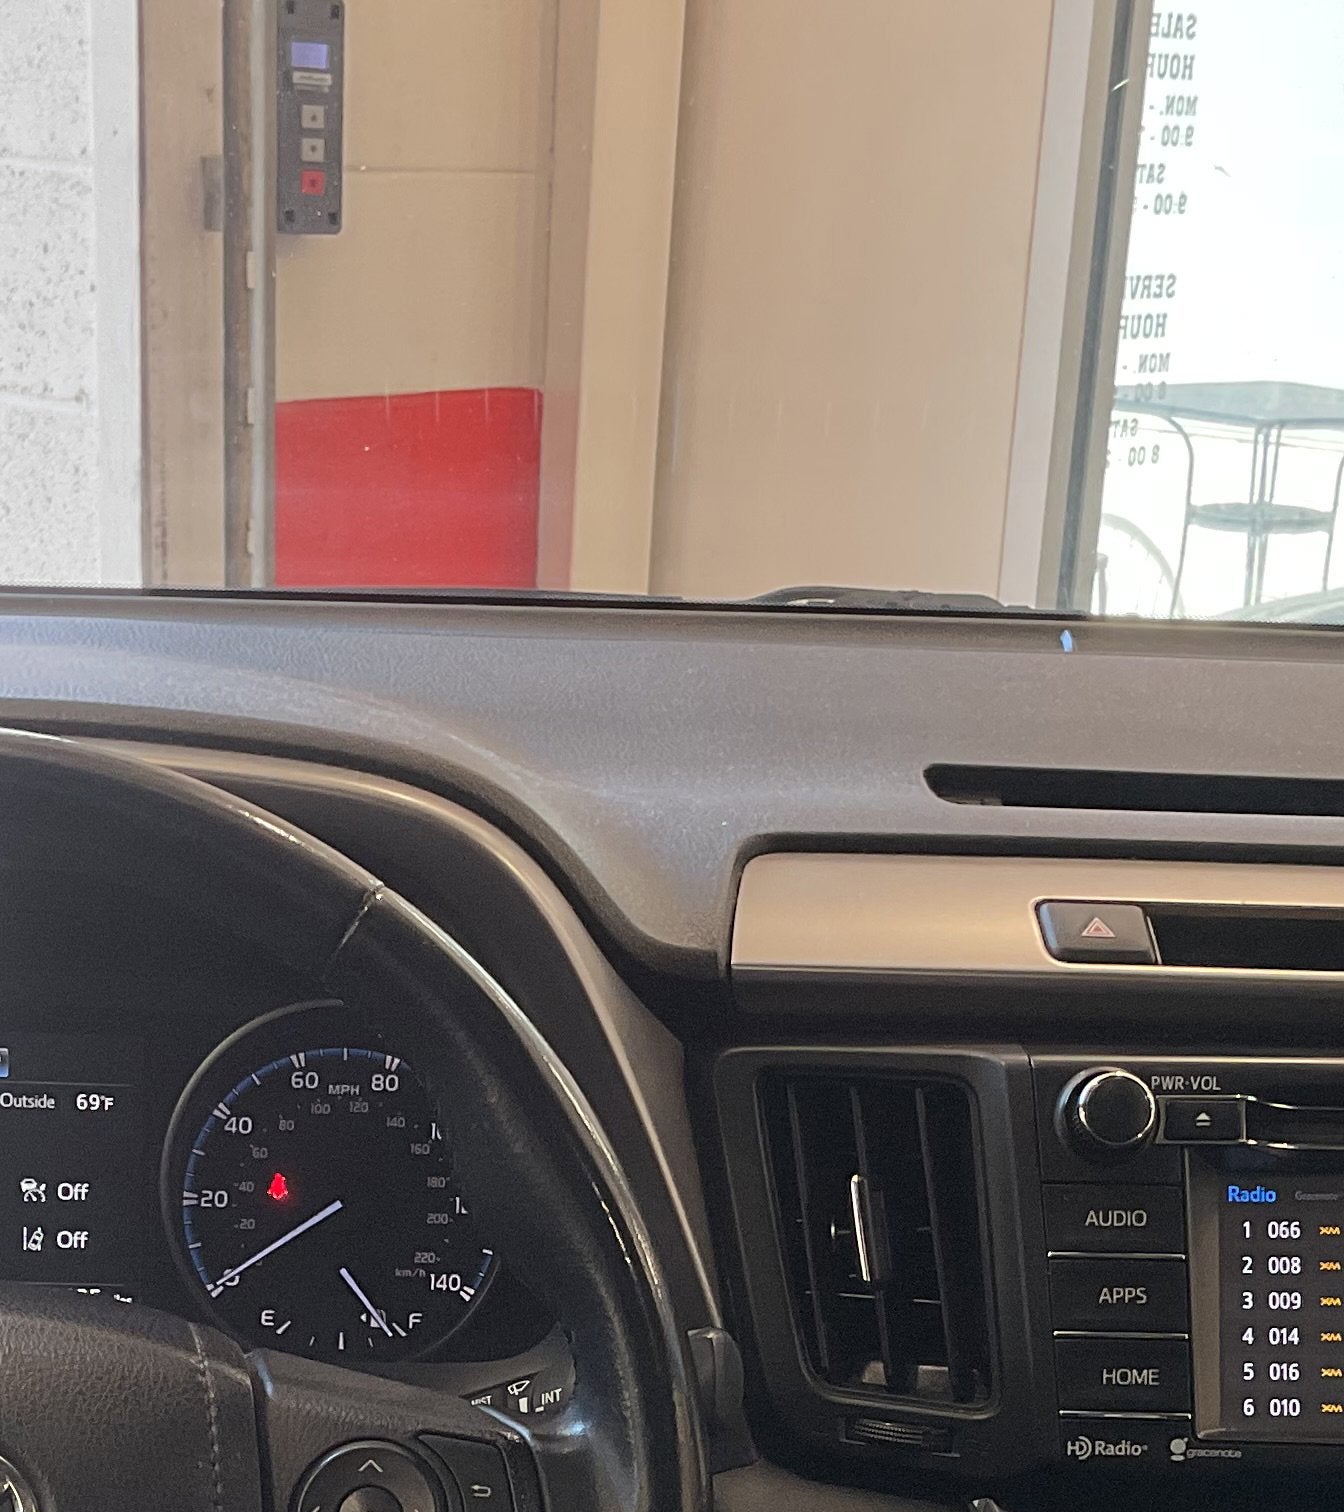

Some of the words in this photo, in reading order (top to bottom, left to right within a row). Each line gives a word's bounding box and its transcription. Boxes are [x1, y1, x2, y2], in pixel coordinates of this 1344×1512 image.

[291, 1072, 319, 1090] 60
[328, 1083, 360, 1096] MPH
[371, 1074, 399, 1092] 80
[0, 1093, 55, 1109] Outside
[349, 1101, 369, 1114] 120
[224, 1116, 252, 1135] 40
[386, 1116, 406, 1128] 140
[410, 1143, 431, 1156] 160
[57, 1183, 90, 1201] Off
[200, 1190, 228, 1207] 20
[1227, 1185, 1277, 1203] Radio
[427, 1212, 449, 1225] 200
[1085, 1210, 1148, 1228] AUDIO
[1243, 1222, 1251, 1238] 1
[1267, 1222, 1301, 1239] 066
[57, 1232, 89, 1250] Off
[395, 1267, 426, 1279] km/h
[1242, 1258, 1253, 1274] 2
[1268, 1257, 1302, 1275] 008
[430, 1272, 461, 1291] 140
[1099, 1287, 1148, 1304] APPS
[1242, 1292, 1254, 1310] 3
[1268, 1292, 1302, 1310] 009
[261, 1310, 275, 1326] E
[409, 1313, 423, 1329] F
[1242, 1328, 1254, 1345] 4
[1268, 1328, 1300, 1346] 014
[1103, 1369, 1160, 1386] HOME
[1243, 1364, 1254, 1381] 5
[1269, 1363, 1300, 1381] 016
[541, 1388, 562, 1406] INT
[1243, 1399, 1254, 1417] 6
[1269, 1399, 1301, 1417] 010
[1187, 1449, 1242, 1459] gracenote
